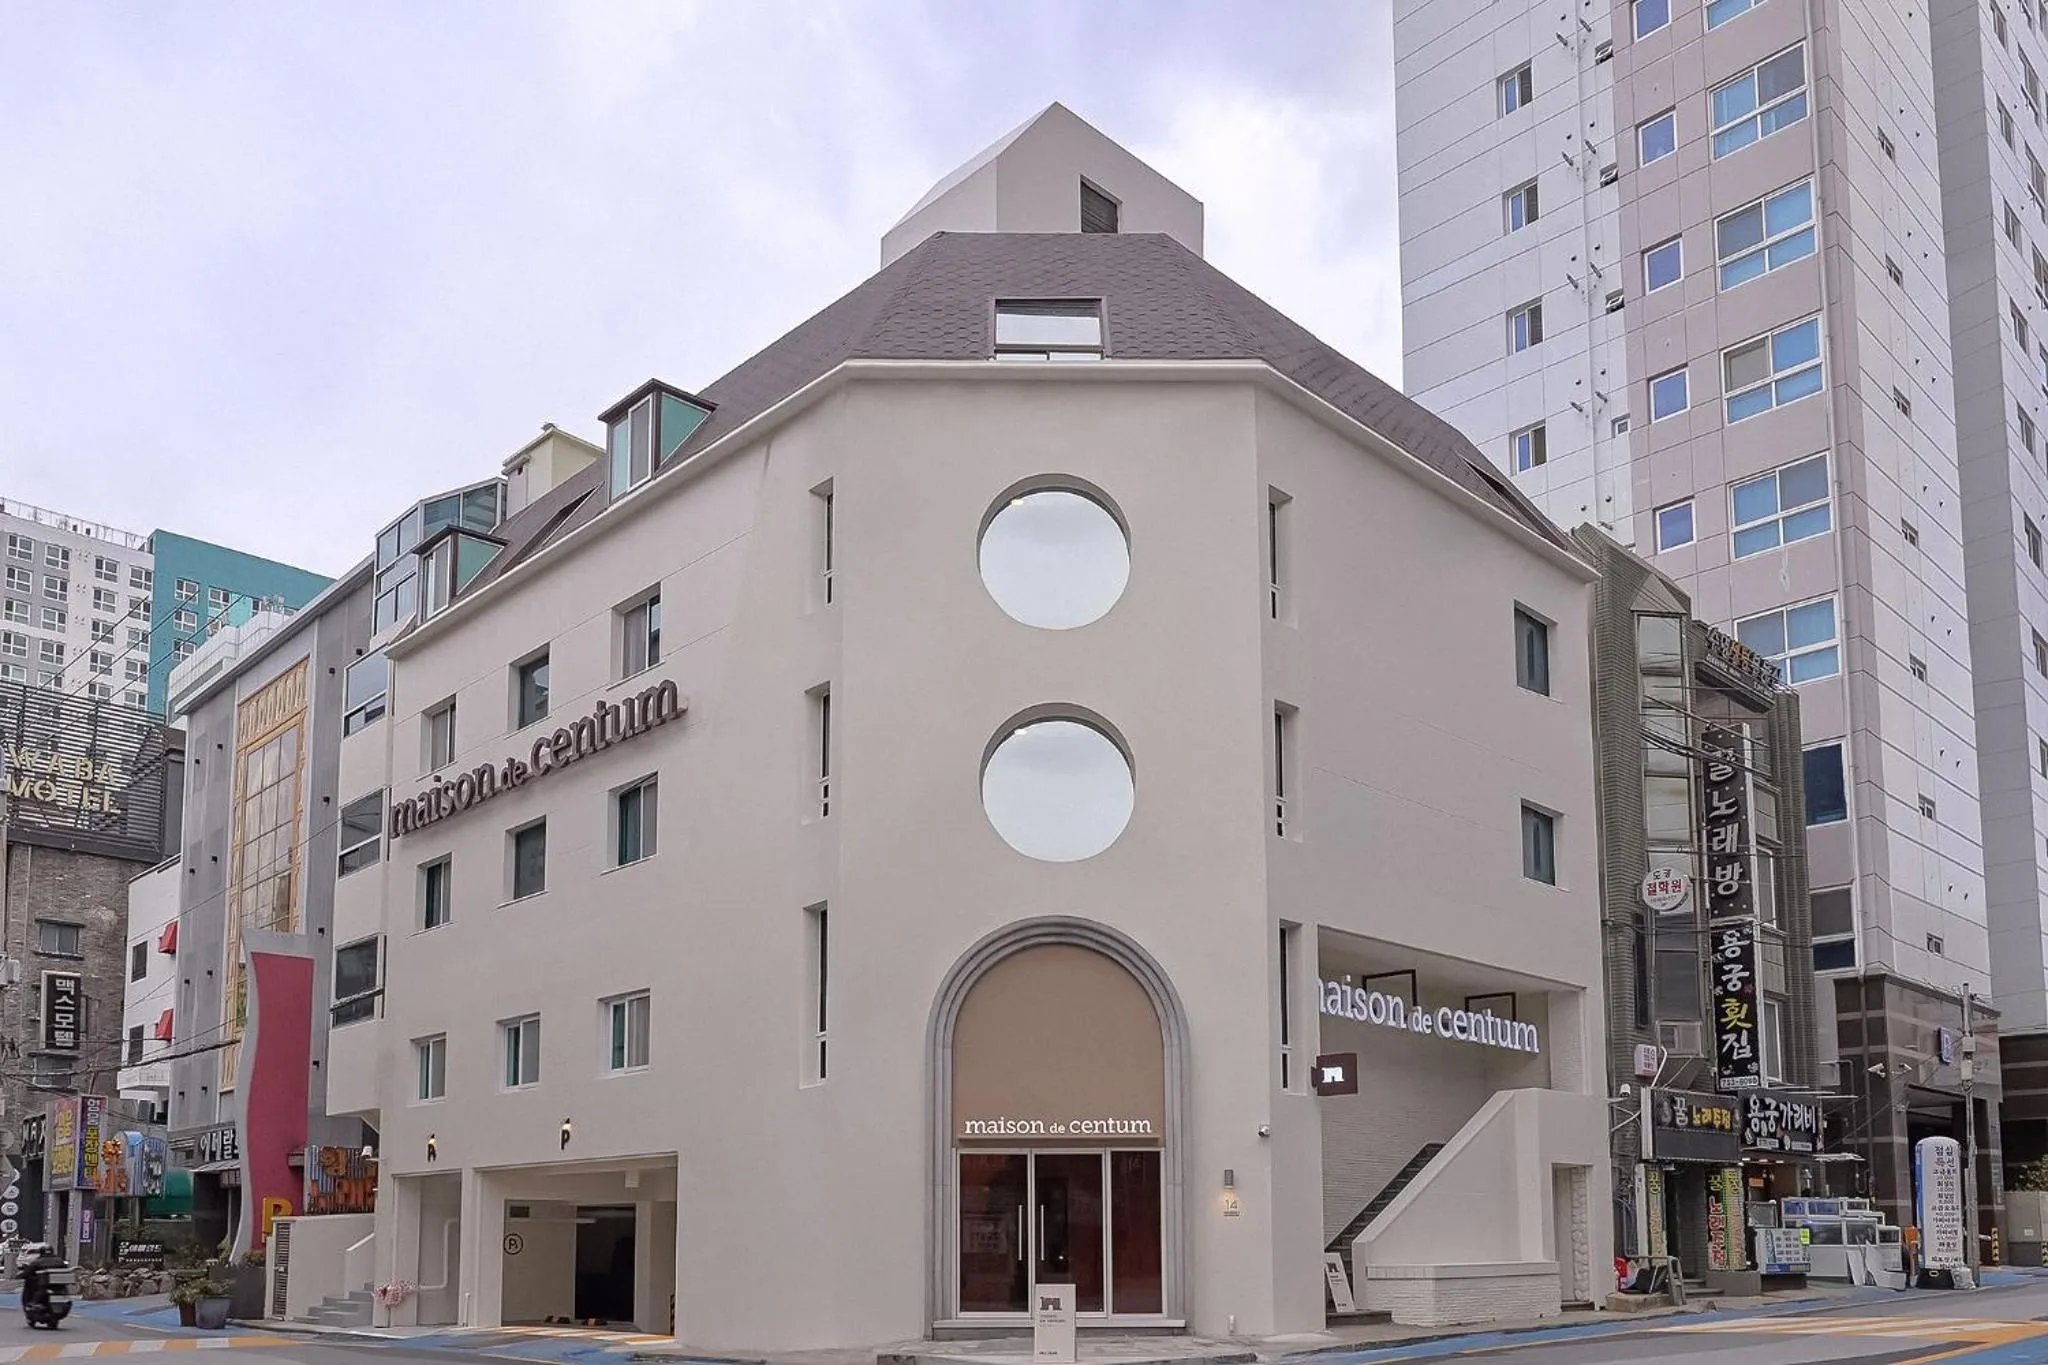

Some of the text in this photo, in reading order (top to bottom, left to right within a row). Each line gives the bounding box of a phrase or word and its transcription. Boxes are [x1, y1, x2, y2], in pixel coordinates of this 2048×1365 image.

[391, 679, 686, 839] maison de centum
[1319, 974, 1540, 1053] aison de centum
[964, 1117, 1152, 1135] maison de centum
[263, 1198, 293, 1243] P
